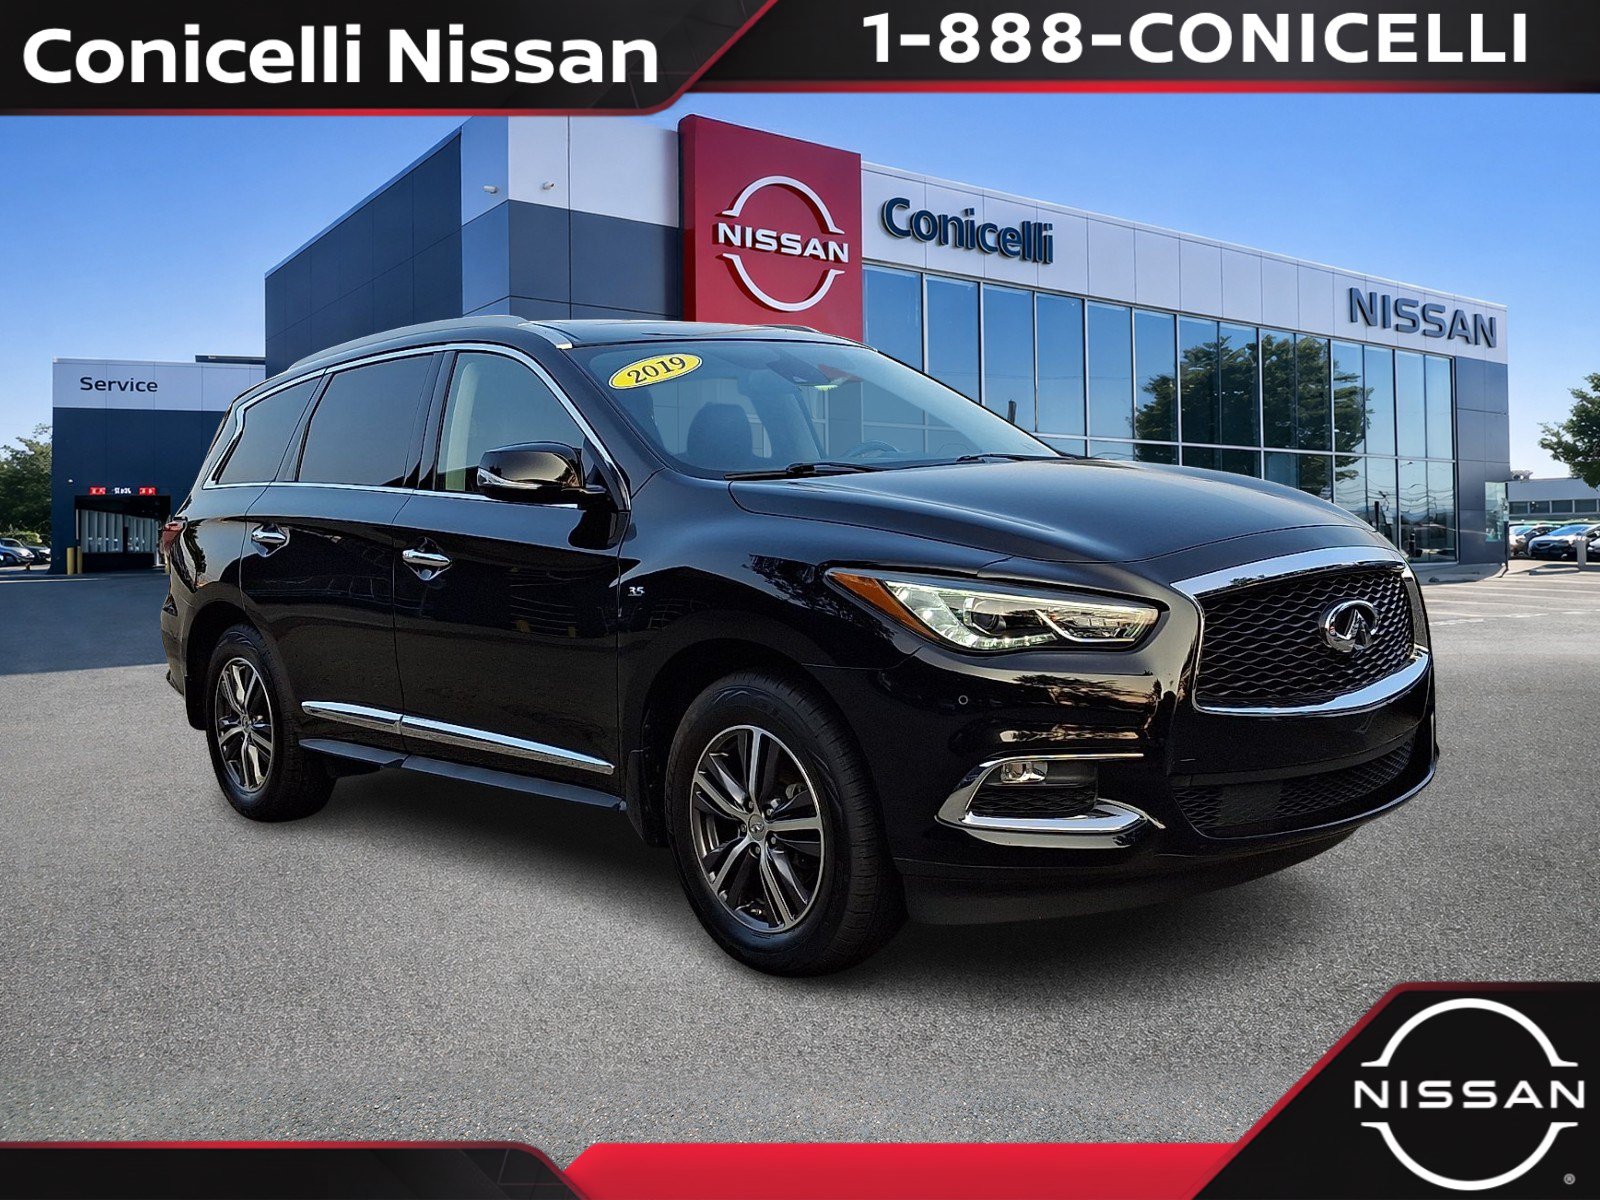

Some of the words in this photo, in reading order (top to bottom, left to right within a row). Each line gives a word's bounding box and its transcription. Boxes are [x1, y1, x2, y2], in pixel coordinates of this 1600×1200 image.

[718, 222, 849, 263] NISSAN
[882, 197, 1053, 264] Conicelli
[1349, 287, 1497, 348] NISSAN
[80, 376, 158, 392] Service
[627, 356, 686, 384] 2019
